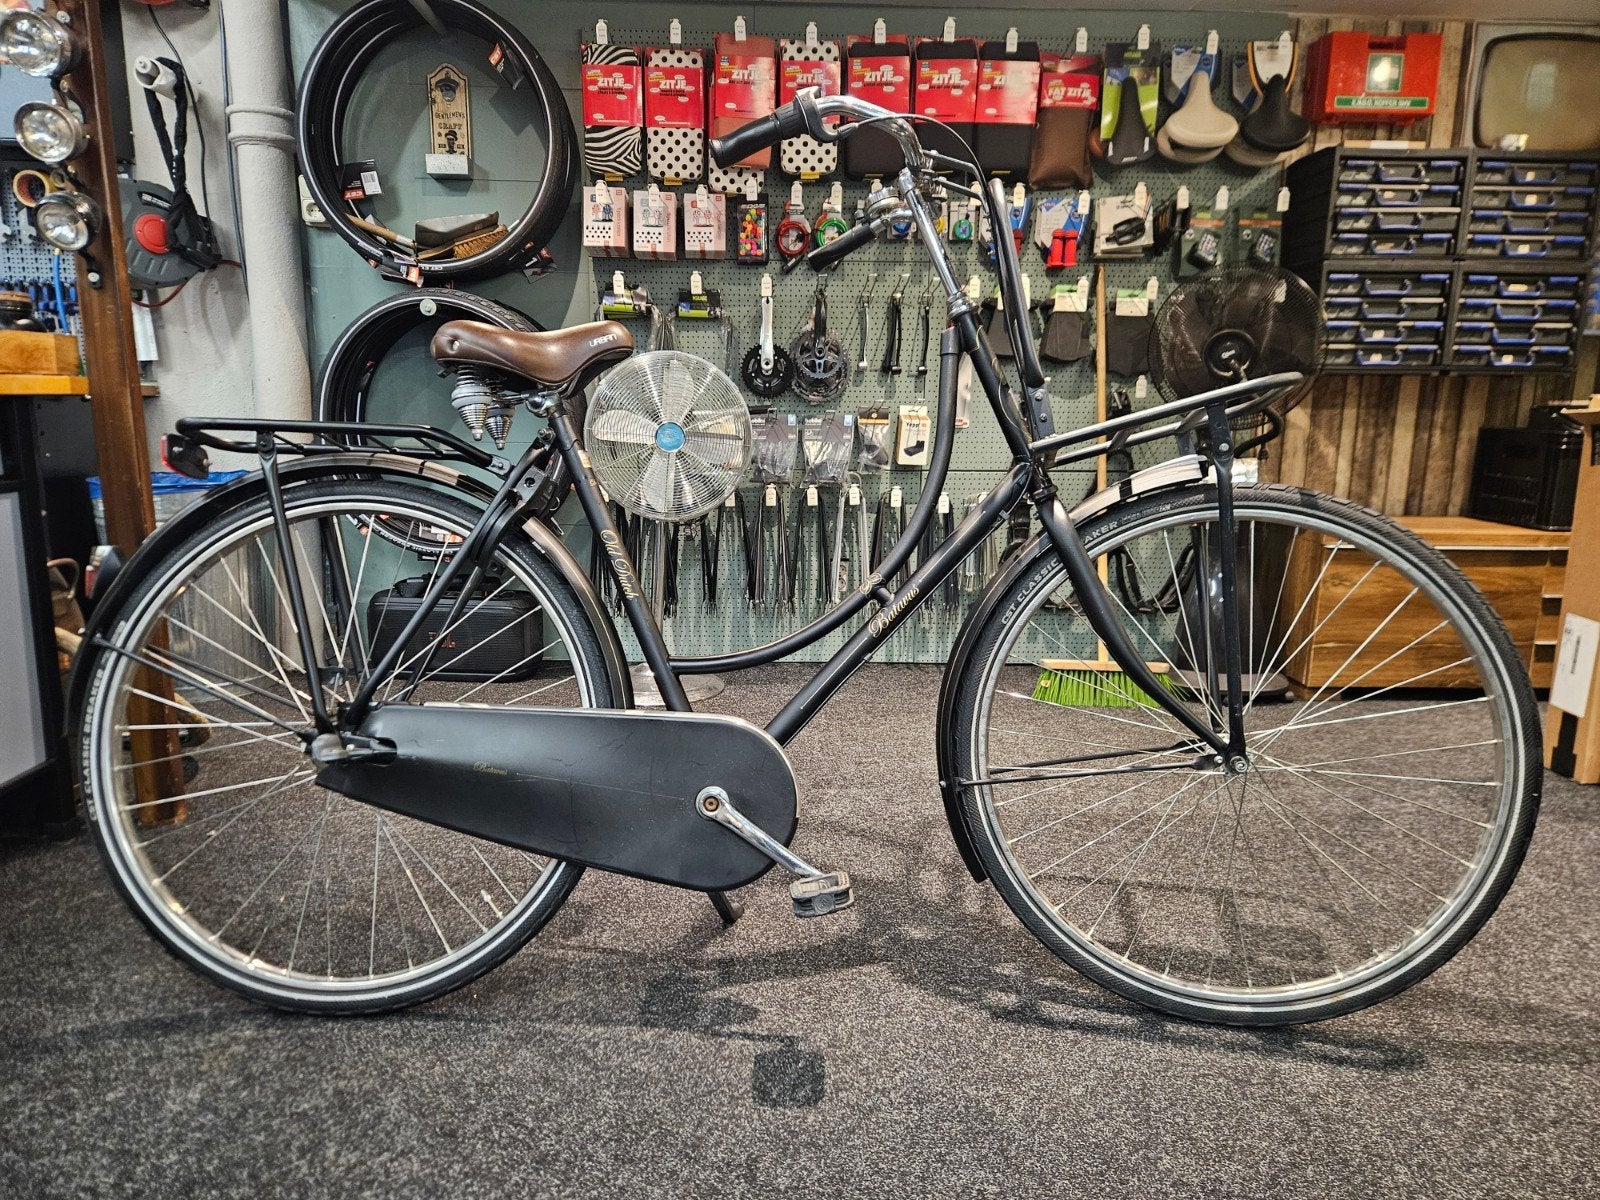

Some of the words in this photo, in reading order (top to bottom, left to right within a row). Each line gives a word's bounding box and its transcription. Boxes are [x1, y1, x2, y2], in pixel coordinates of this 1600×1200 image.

[597, 77, 624, 87] ZITJE
[659, 79, 686, 89] ZITJE
[796, 73, 824, 83] ZITJE
[864, 70, 894, 82] ZITJE
[932, 73, 961, 85] ZITJE
[589, 333, 617, 347] URBAN
[1084, 521, 1118, 544] AKER
[600, 529, 622, 556] Old
[611, 558, 639, 600] Dutch
[1001, 603, 1017, 624] CST
[1017, 557, 1060, 602] CLASSIC
[868, 583, 920, 638] Batavus
[83, 668, 104, 733] BREAKER
[82, 735, 92, 794] CLASSIC
[86, 798, 98, 821] CST
